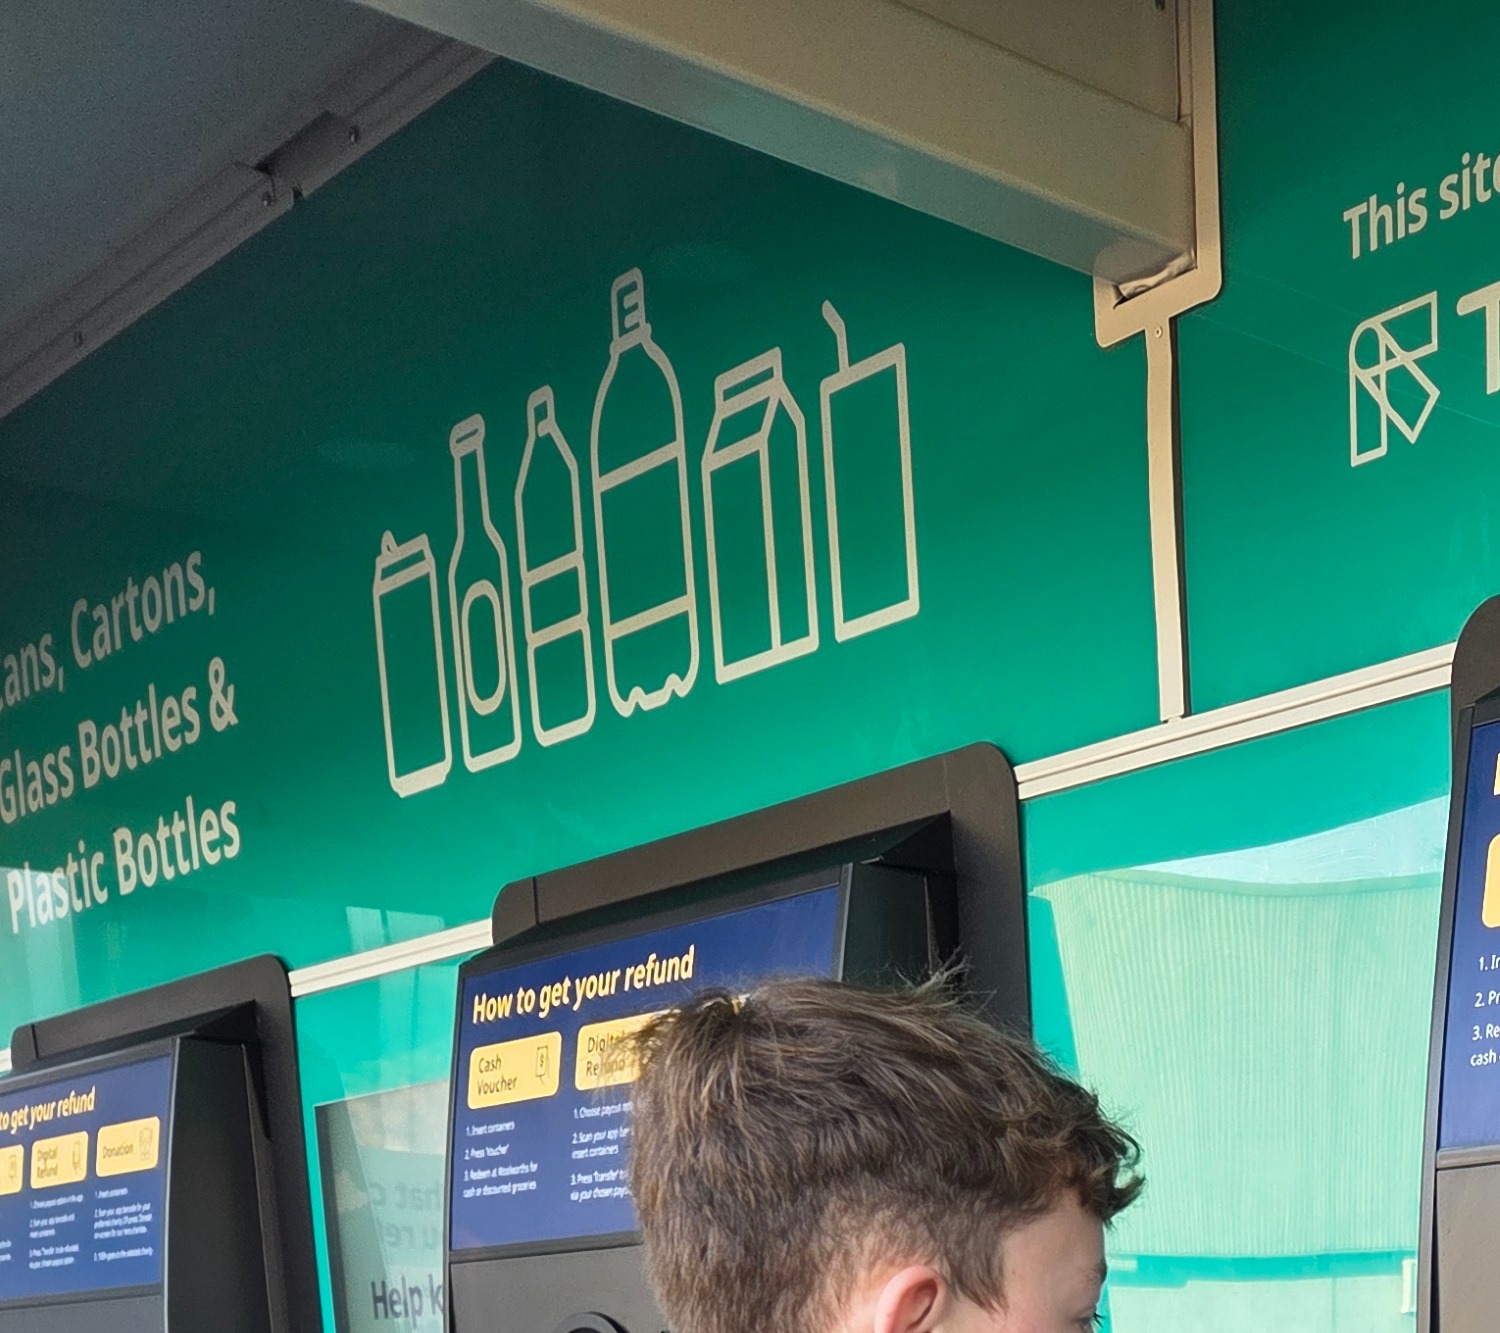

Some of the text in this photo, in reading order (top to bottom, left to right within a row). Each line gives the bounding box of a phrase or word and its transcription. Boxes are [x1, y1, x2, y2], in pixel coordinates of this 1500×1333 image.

[1343, 182, 1428, 259] This
[0, 551, 215, 710] ans, Cartons,
[0, 656, 238, 824] Glass Bottles &
[7, 796, 240, 934] Plastic Bottles
[473, 945, 694, 1023] How to get your refund
[1479, 957, 1487, 971] 1.
[1474, 993, 1485, 1007] 2.
[1472, 1026, 1482, 1040] 3.
[479, 1054, 502, 1073] Cash
[1470, 1049, 1496, 1067] cash
[11, 1086, 96, 1134] get your refund
[477, 1076, 517, 1096] Voucher
[371, 1273, 424, 1329] Help
